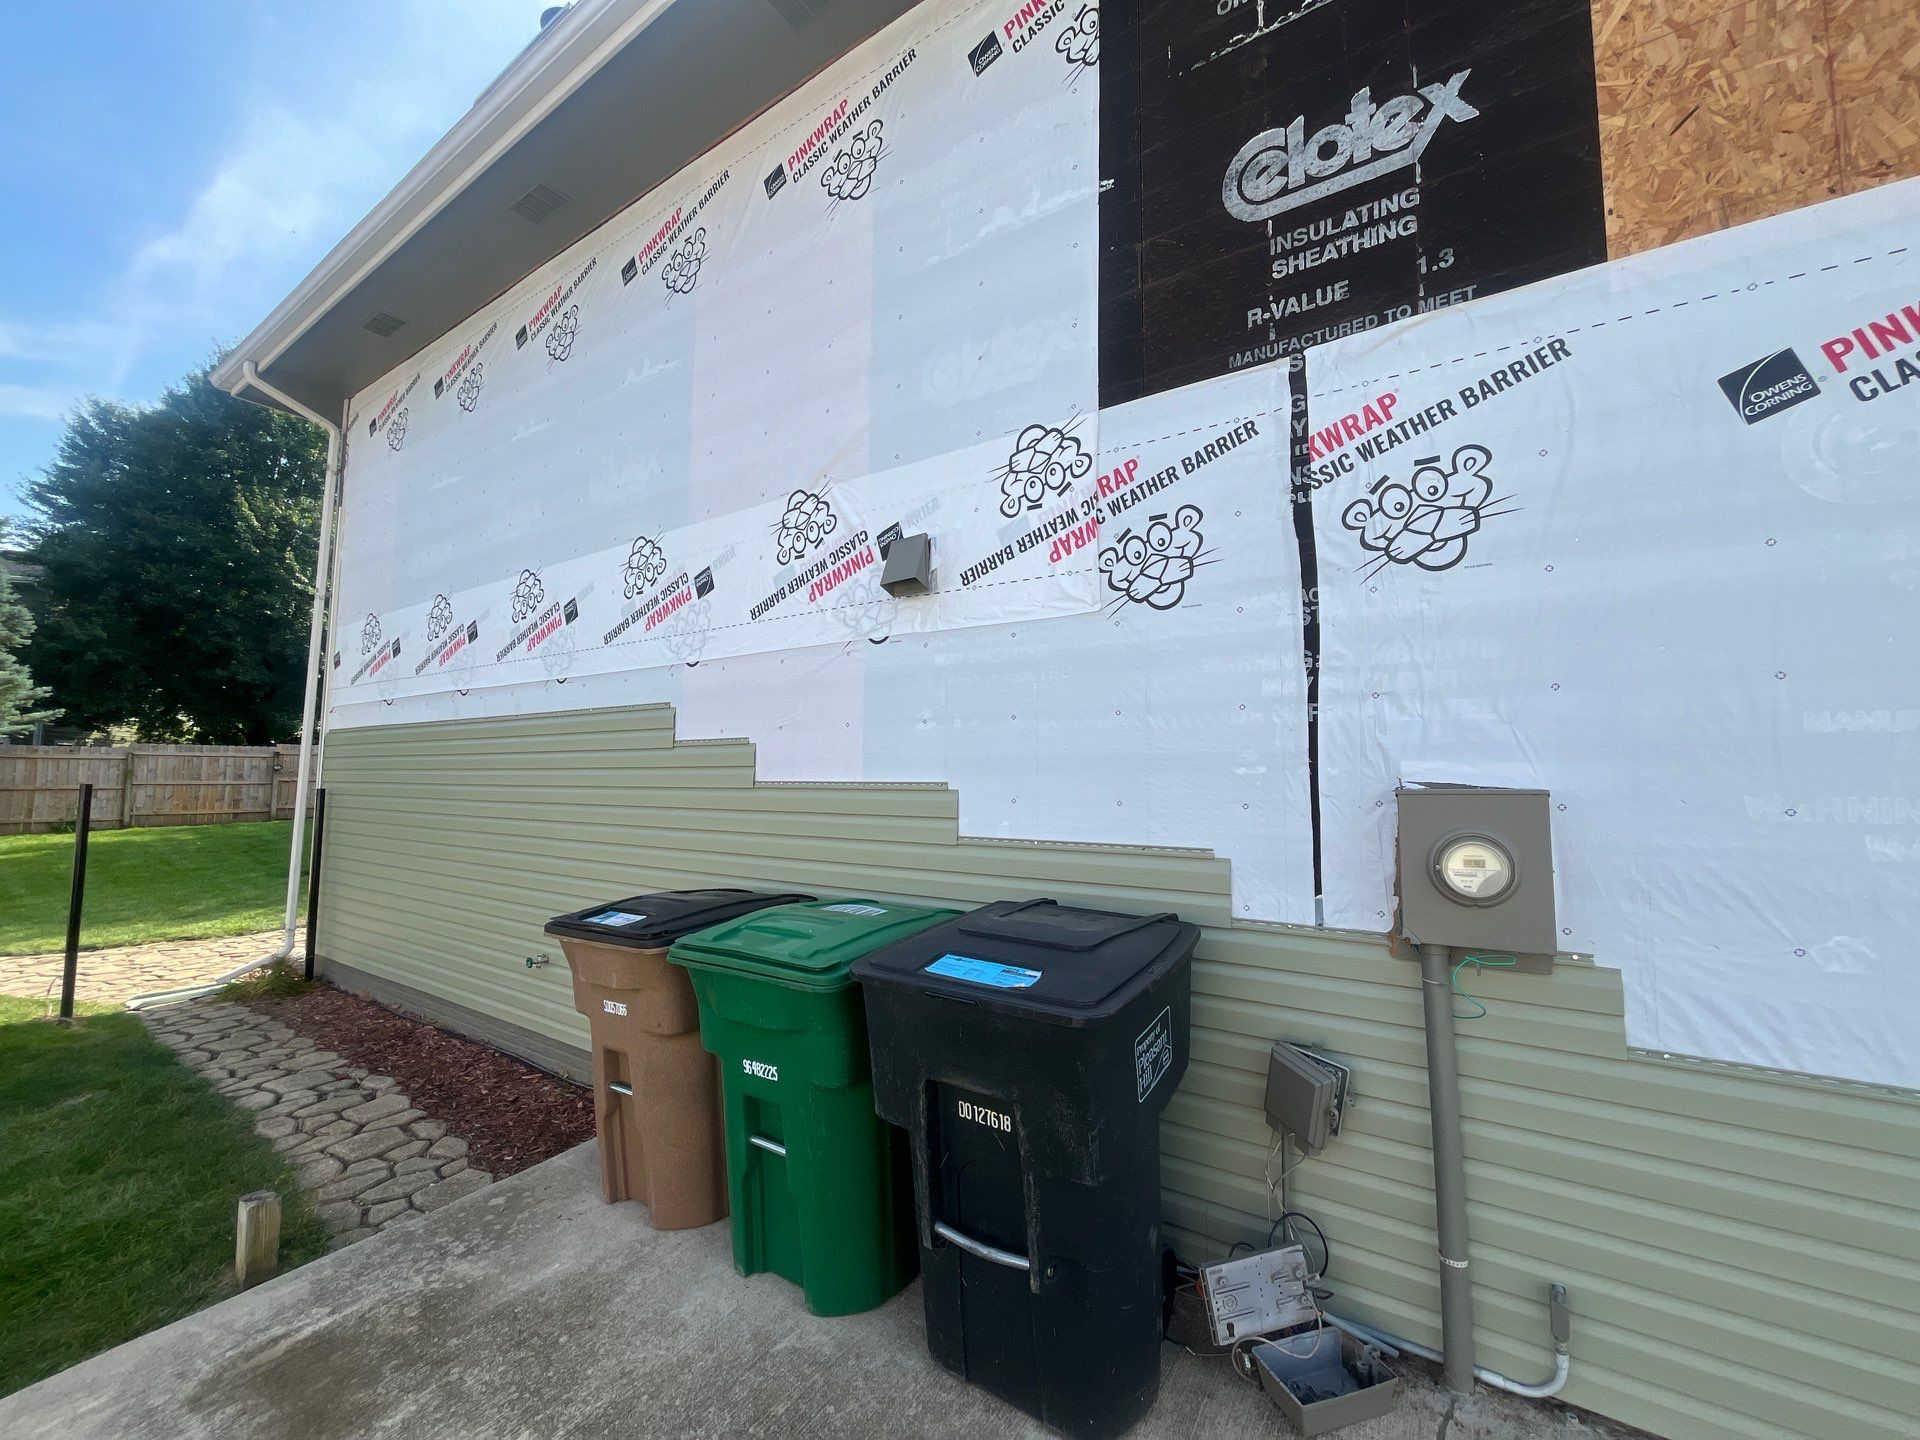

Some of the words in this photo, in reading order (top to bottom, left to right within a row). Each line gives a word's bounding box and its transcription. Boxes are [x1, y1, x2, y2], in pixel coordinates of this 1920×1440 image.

[1012, 0, 1064, 53] CLASSIC
[787, 99, 849, 171] PINKWRAP
[792, 141, 829, 183] CLASSIC
[828, 96, 872, 144] WEATHER
[871, 48, 917, 99] BARRIER
[1222, 68, 1480, 222] Celotex
[638, 206, 682, 265] PINKWRAP
[641, 242, 668, 275] CLASSIC
[667, 207, 698, 245] WEATHER
[699, 170, 730, 211] BARRIER
[1269, 187, 1421, 255] INSULATING
[1271, 215, 1418, 279] SHEATHING
[528, 285, 563, 332] PINKWRAP
[550, 286, 574, 317] WEATHER
[1247, 280, 1350, 330] R-VALUE
[1415, 248, 1455, 275] 1.3
[1228, 314, 1379, 369] MANUFACTURED
[1384, 304, 1412, 324] TO
[1418, 285, 1477, 315] MEET
[1744, 381, 1813, 416] CORNING
[1750, 373, 1807, 403] OWENS
[1849, 351, 1920, 402] CLA
[1354, 398, 1458, 463] WEATHER
[1458, 338, 1572, 410] BARRIER
[1097, 458, 1140, 498] RAP
[1106, 465, 1181, 517] WEATHER
[1180, 420, 1260, 475] BARRIER
[830, 530, 869, 565] CLASSIC
[1016, 507, 1080, 554] WEATHER
[660, 572, 689, 601] CLASSIC
[787, 558, 829, 595] WEATHER
[808, 544, 875, 603] PINKWRAP
[959, 544, 1016, 587] BARRIER
[539, 601, 561, 626] CLASSIC
[630, 594, 661, 624] WEATHER
[645, 585, 692, 632] PINKWRAP
[749, 585, 788, 621] BARRIER
[495, 638, 517, 662] BARRIER
[516, 621, 539, 645] WEATHER
[527, 613, 563, 652] PINKWRAP
[603, 619, 631, 645] BARRIER
[1138, 1029, 1168, 1076] Pleasant
[1140, 1064, 1153, 1094] Hill
